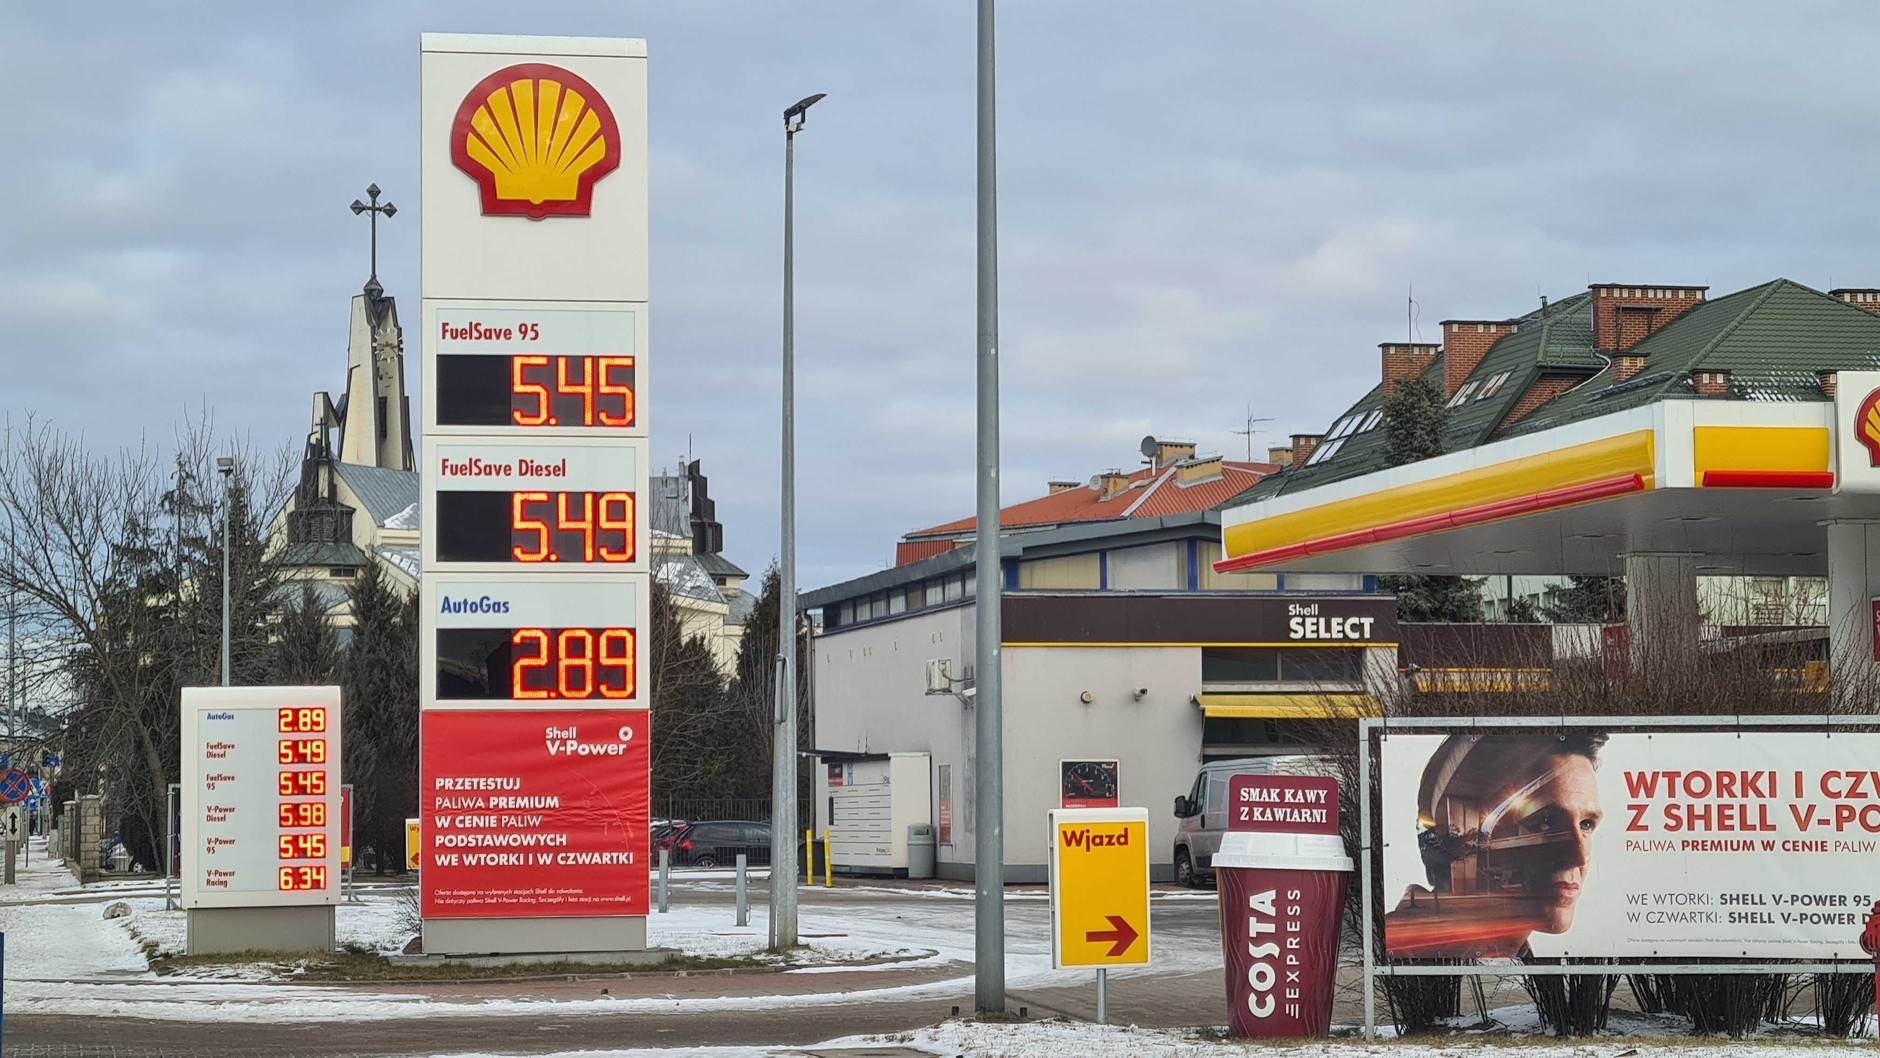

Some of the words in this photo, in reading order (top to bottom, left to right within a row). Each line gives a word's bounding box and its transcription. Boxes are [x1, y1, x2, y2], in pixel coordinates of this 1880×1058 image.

[441, 322, 512, 341] FuelSave
[518, 323, 539, 341] 95
[512, 355, 634, 427] 5.45
[441, 458, 512, 476] FuelSave
[518, 458, 566, 477] Diesel
[512, 490, 634, 562] 5.49
[440, 596, 510, 614] AutoGas
[1288, 604, 1318, 616] Shell
[1289, 616, 1374, 639] SELECT
[512, 628, 635, 699] 2.89
[206, 712, 234, 721] AutoGas
[280, 709, 325, 732] 2.89
[546, 727, 576, 738] Shell
[206, 742, 236, 750] FuelSave
[280, 741, 325, 763] 5.49
[546, 740, 626, 756] V-Power
[206, 750, 226, 759] Diesel
[206, 774, 236, 782] FuelSave
[280, 773, 325, 794] 5.45
[435, 778, 521, 790] PRZETESTUJ
[1623, 771, 1776, 799] WTORKI
[1794, 771, 1803, 798] I
[1820, 770, 1880, 799] CZ
[206, 782, 216, 791] 95
[435, 796, 485, 809] PALIWA
[490, 796, 559, 808] PREMIUM
[1240, 788, 1280, 802] SMAK
[1284, 788, 1328, 804] KAWY
[206, 805, 236, 814] V-Power
[280, 804, 325, 826] 5.98
[1240, 808, 1250, 820] Z
[1252, 808, 1327, 824] KAWIARNI
[206, 814, 226, 822] Diesel
[435, 816, 452, 828] W
[455, 816, 497, 828] CENIE
[502, 815, 542, 827] PALIW
[1626, 804, 1650, 832] Z
[1664, 804, 1776, 832] SHELL
[206, 837, 236, 846] V-Power
[280, 836, 325, 858] 5.45
[435, 834, 567, 848] PODSTAWOWYCH
[1062, 828, 1128, 852] Wjazd
[1626, 840, 1676, 852] PALIWA
[1682, 840, 1756, 852] PREMIUM
[1761, 840, 1776, 852] W
[1782, 840, 1828, 852] CENIE
[1834, 840, 1876, 852] PALIW
[206, 846, 216, 854] 95
[435, 854, 458, 866] WE
[463, 853, 524, 866] WTORKI
[537, 853, 552, 865] W
[557, 852, 633, 865] CZWARTKI
[206, 869, 236, 878] V-Power
[280, 868, 325, 890] 6.34
[206, 878, 228, 888] Racing
[1626, 894, 1648, 906] WE
[1653, 893, 1714, 906] WTORKI:
[1720, 894, 1766, 906] SHELL
[1772, 894, 1848, 906] V-POWER
[1853, 895, 1871, 907] 95
[1626, 912, 1640, 923] W
[1646, 912, 1722, 924] CZWARTKI:
[1728, 912, 1775, 924] SHELL
[1780, 912, 1856, 925] V-POWER
[1286, 890, 1300, 999] EXPRESS
[1248, 889, 1280, 1018] COSTA
